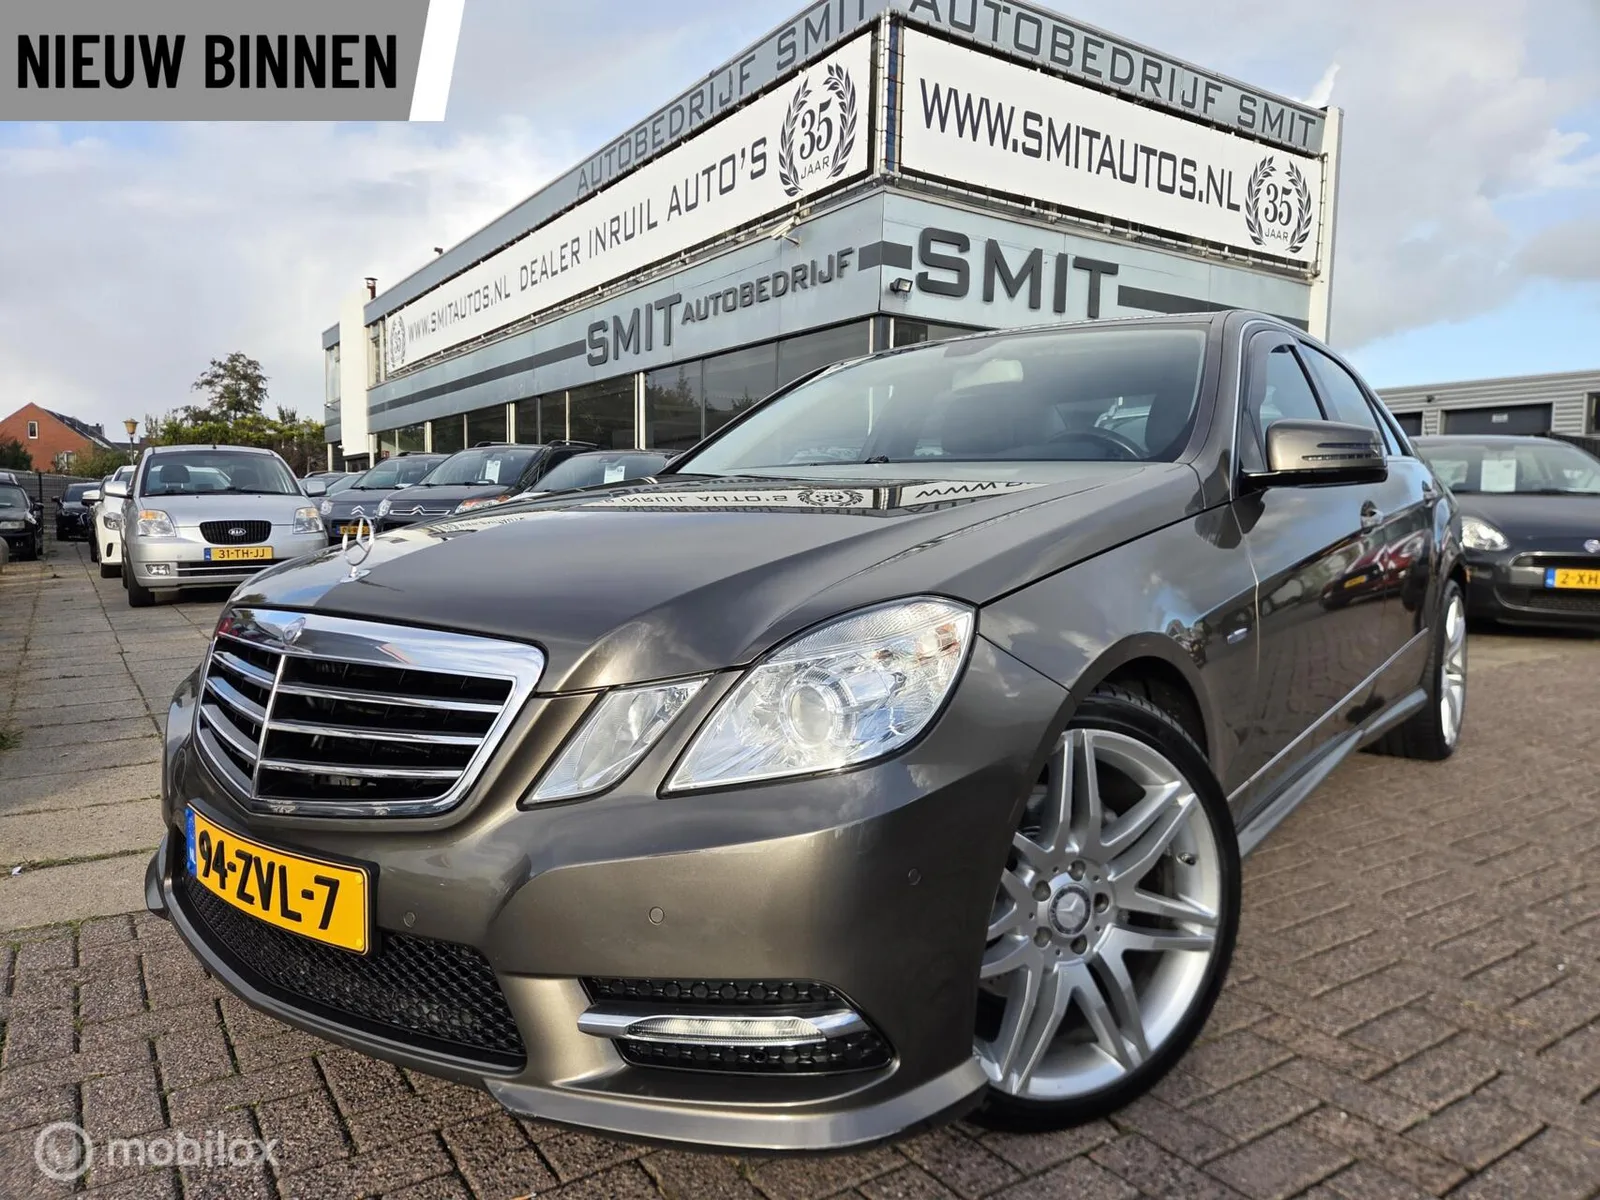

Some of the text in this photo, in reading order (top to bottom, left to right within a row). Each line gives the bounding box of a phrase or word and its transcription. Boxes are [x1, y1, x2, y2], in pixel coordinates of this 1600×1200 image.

[576, 53, 757, 197] AUTOBEDRIJF
[799, 96, 834, 160] 35
[919, 77, 1241, 212] WWW.SMITAUTOS.NL
[1236, 93, 1317, 148] SMIT
[800, 155, 830, 180] JAAR
[1263, 182, 1293, 224] 35
[407, 135, 768, 345] WWW.SMITAUTOS.NL DEALER INRUIL AUTO'S
[917, 226, 1119, 319] SMIT
[1264, 228, 1289, 243] JAAR
[587, 246, 855, 367] SMIT AUTOBEDRIJF
[218, 548, 266, 559] 31-TH-JJ
[198, 829, 341, 931] 94-ZVL-7
